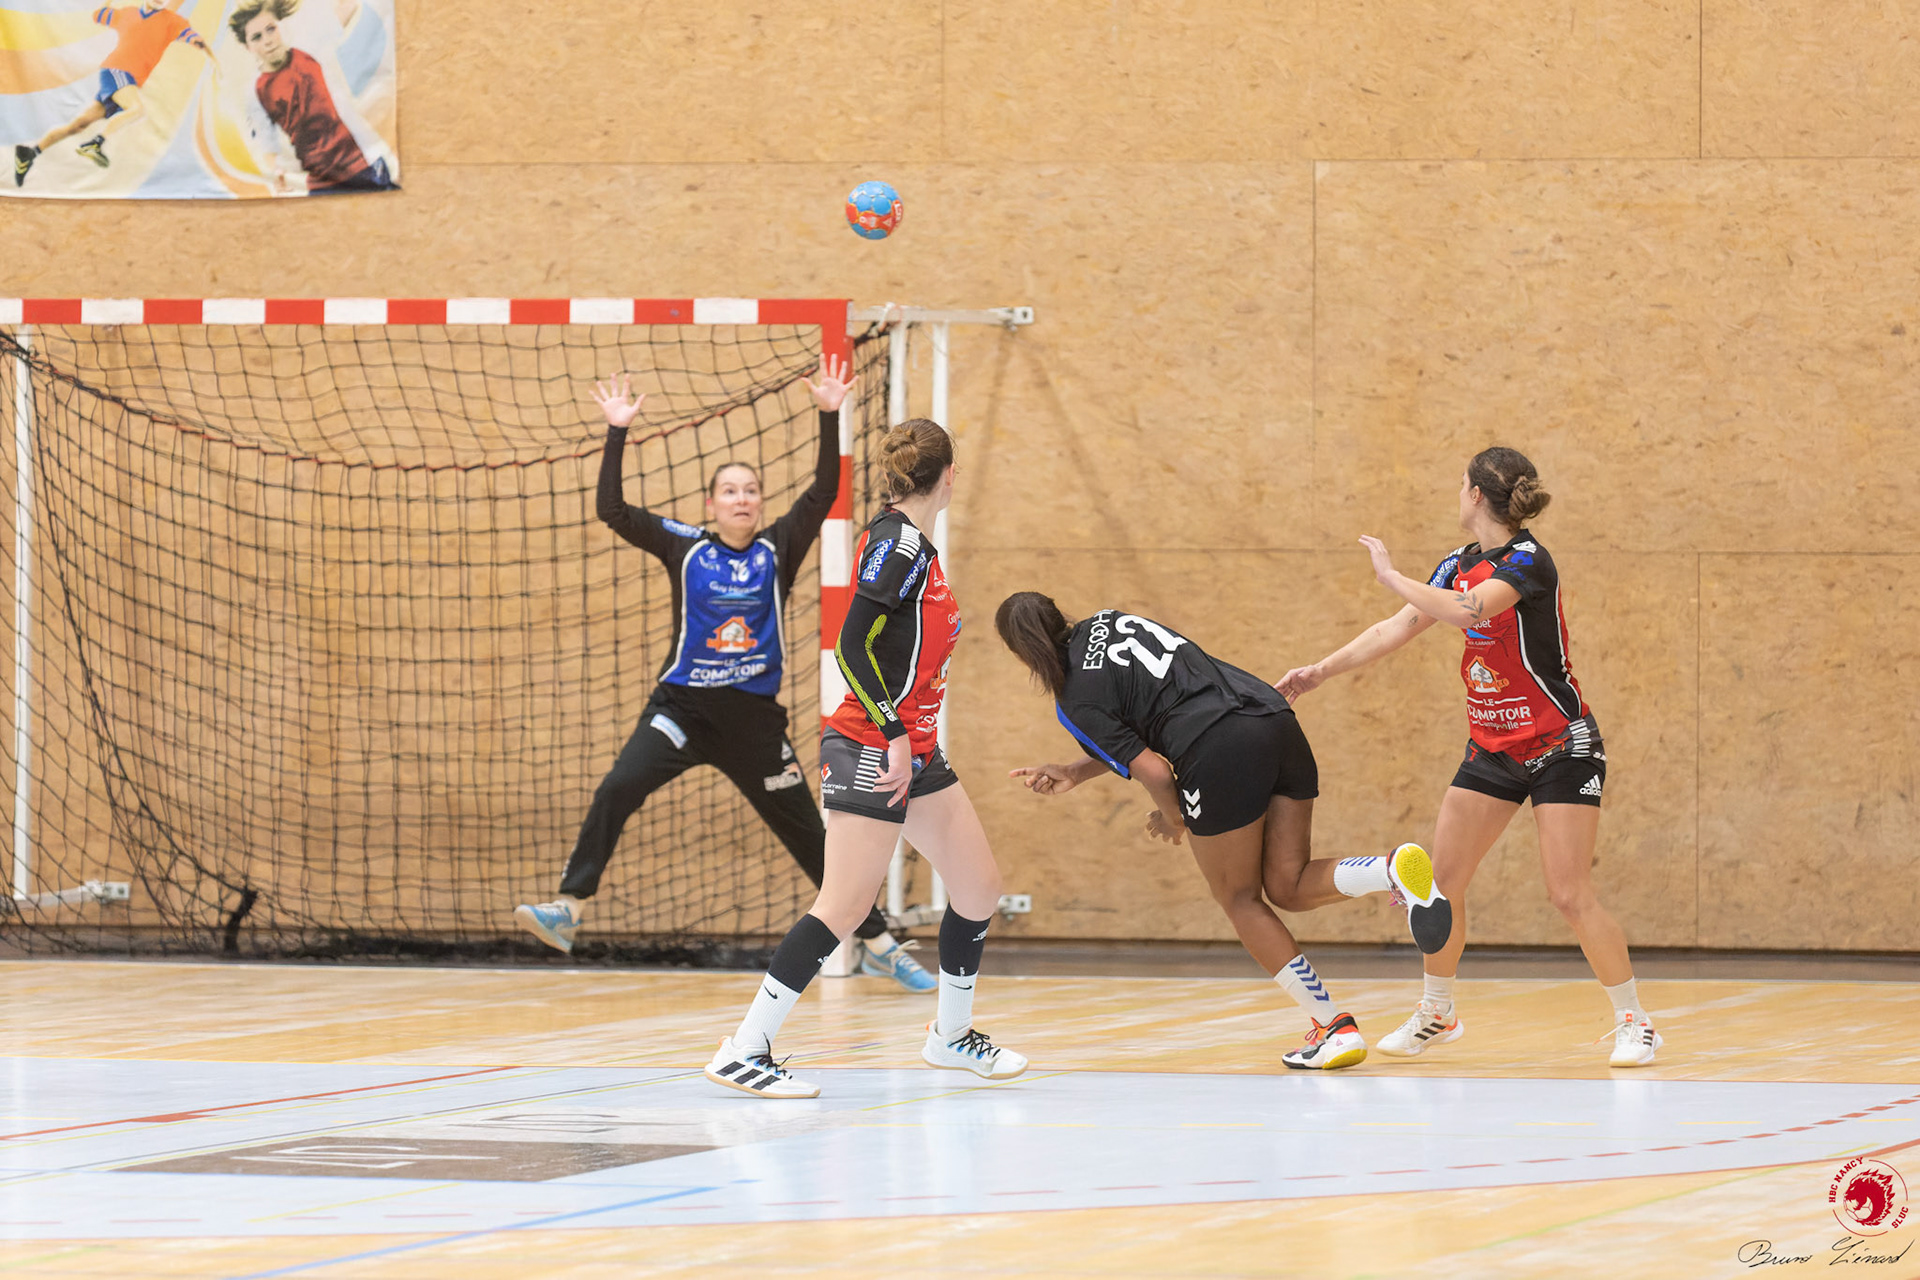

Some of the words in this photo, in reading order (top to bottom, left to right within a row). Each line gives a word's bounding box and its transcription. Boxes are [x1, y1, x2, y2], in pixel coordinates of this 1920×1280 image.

[728, 558, 750, 582] 16
[1471, 618, 1492, 631] quet
[1106, 614, 1188, 679] 22
[689, 662, 768, 680] COMPTOIR
[1483, 698, 1495, 707] LE
[1466, 704, 1532, 722] COMPTOIR
